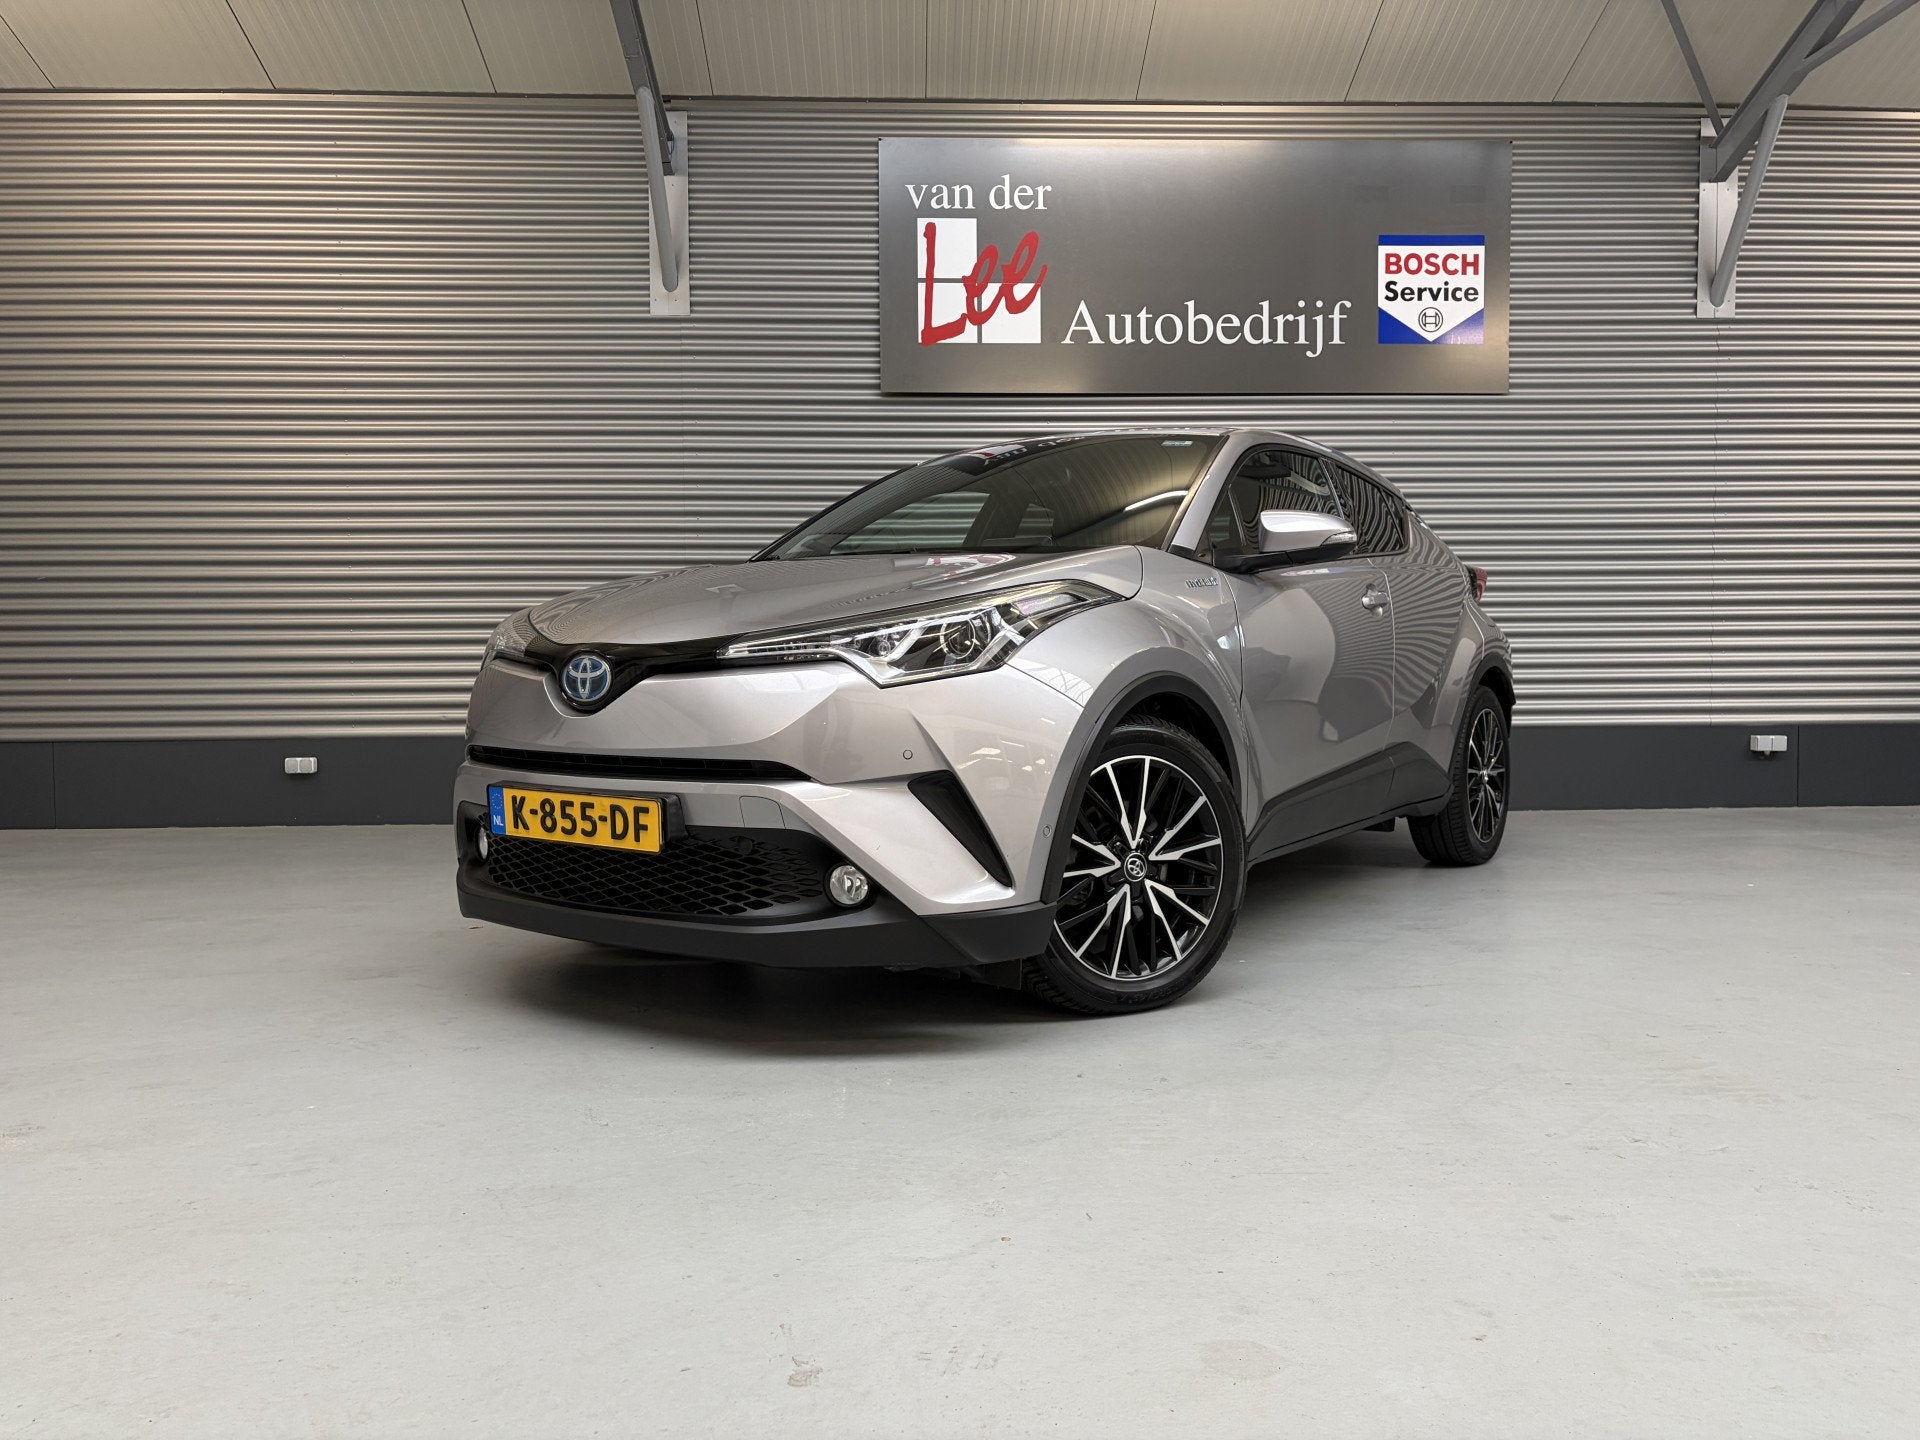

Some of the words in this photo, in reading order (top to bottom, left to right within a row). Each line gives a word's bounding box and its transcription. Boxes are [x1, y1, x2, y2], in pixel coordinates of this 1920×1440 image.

[905, 183, 976, 209] van
[989, 174, 1052, 210] der
[1385, 253, 1480, 275] BOSCH
[921, 222, 1047, 347] Lee
[1384, 281, 1479, 302] Service
[1061, 300, 1352, 357] Autobedrijf
[493, 813, 504, 826] NL
[511, 795, 649, 842] K-855-DF
